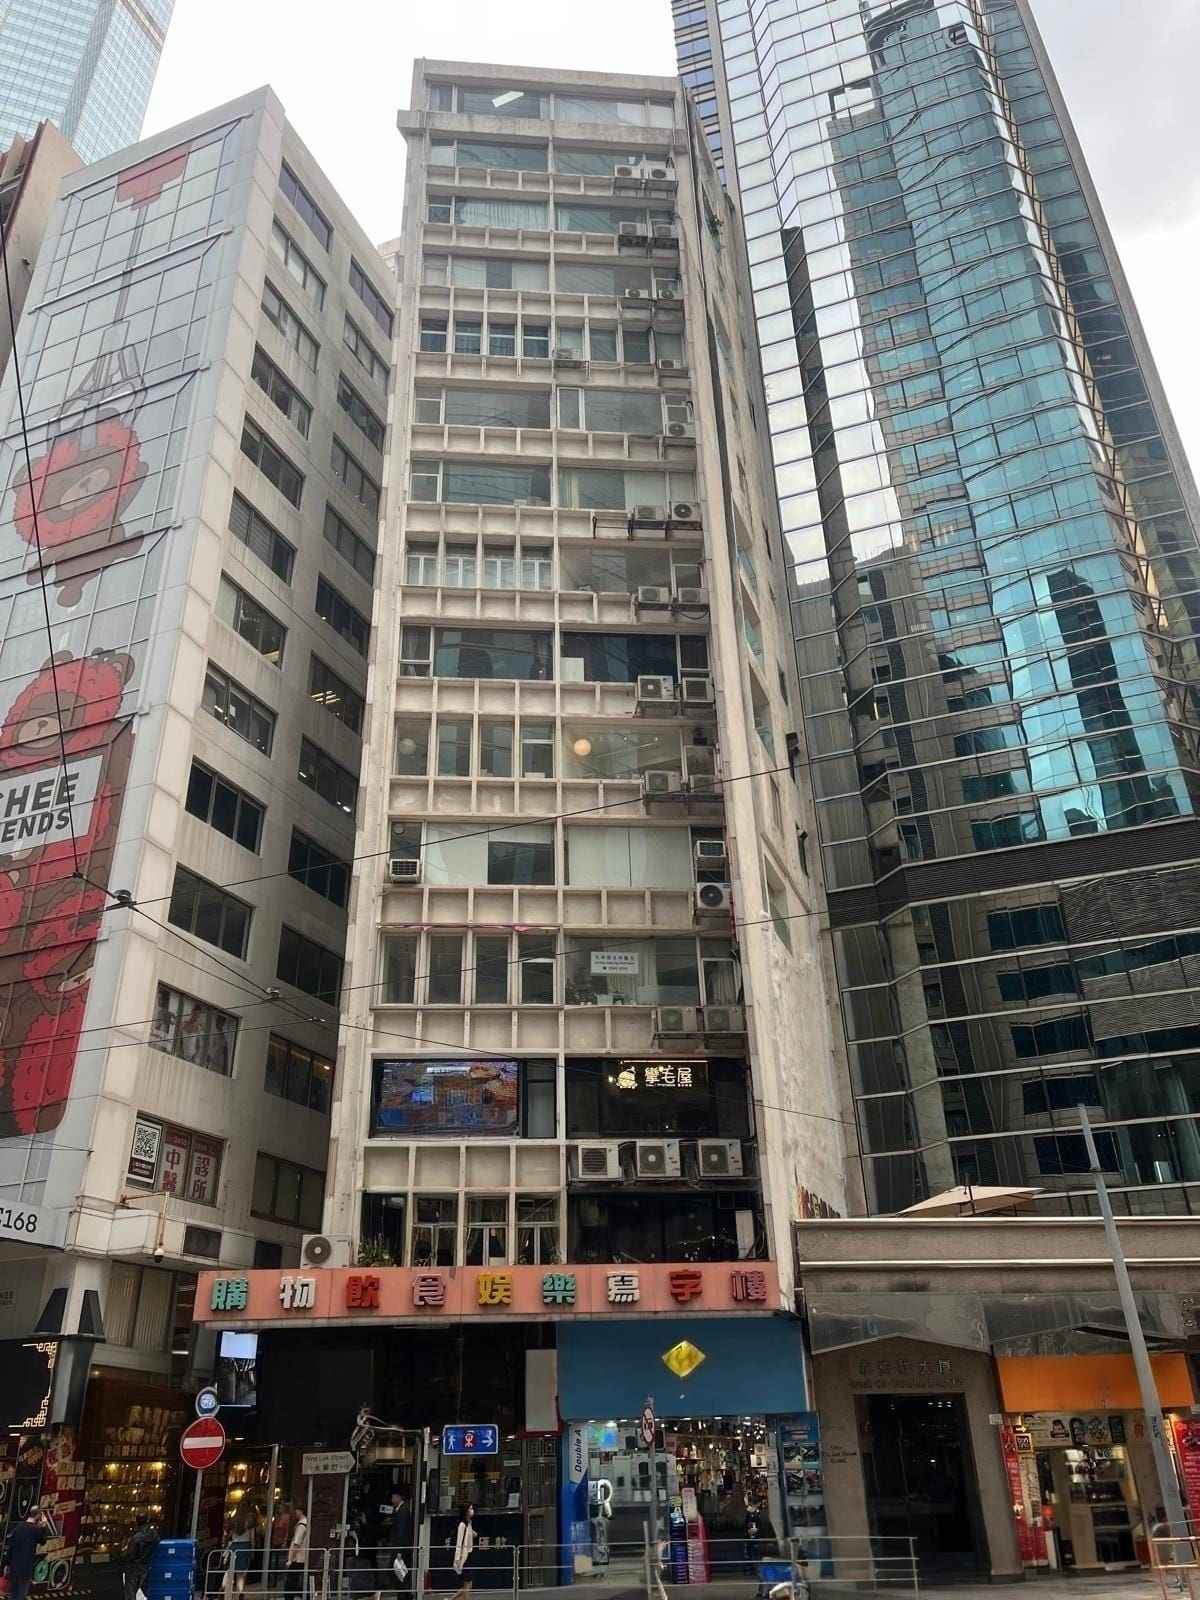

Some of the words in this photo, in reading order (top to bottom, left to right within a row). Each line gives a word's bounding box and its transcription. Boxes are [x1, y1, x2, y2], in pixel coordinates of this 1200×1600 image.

[0, 772, 79, 818] HEE
[162, 1148, 181, 1192] 中醫
[192, 1156, 210, 1200] 診所
[574, 1438, 582, 1473] Double
